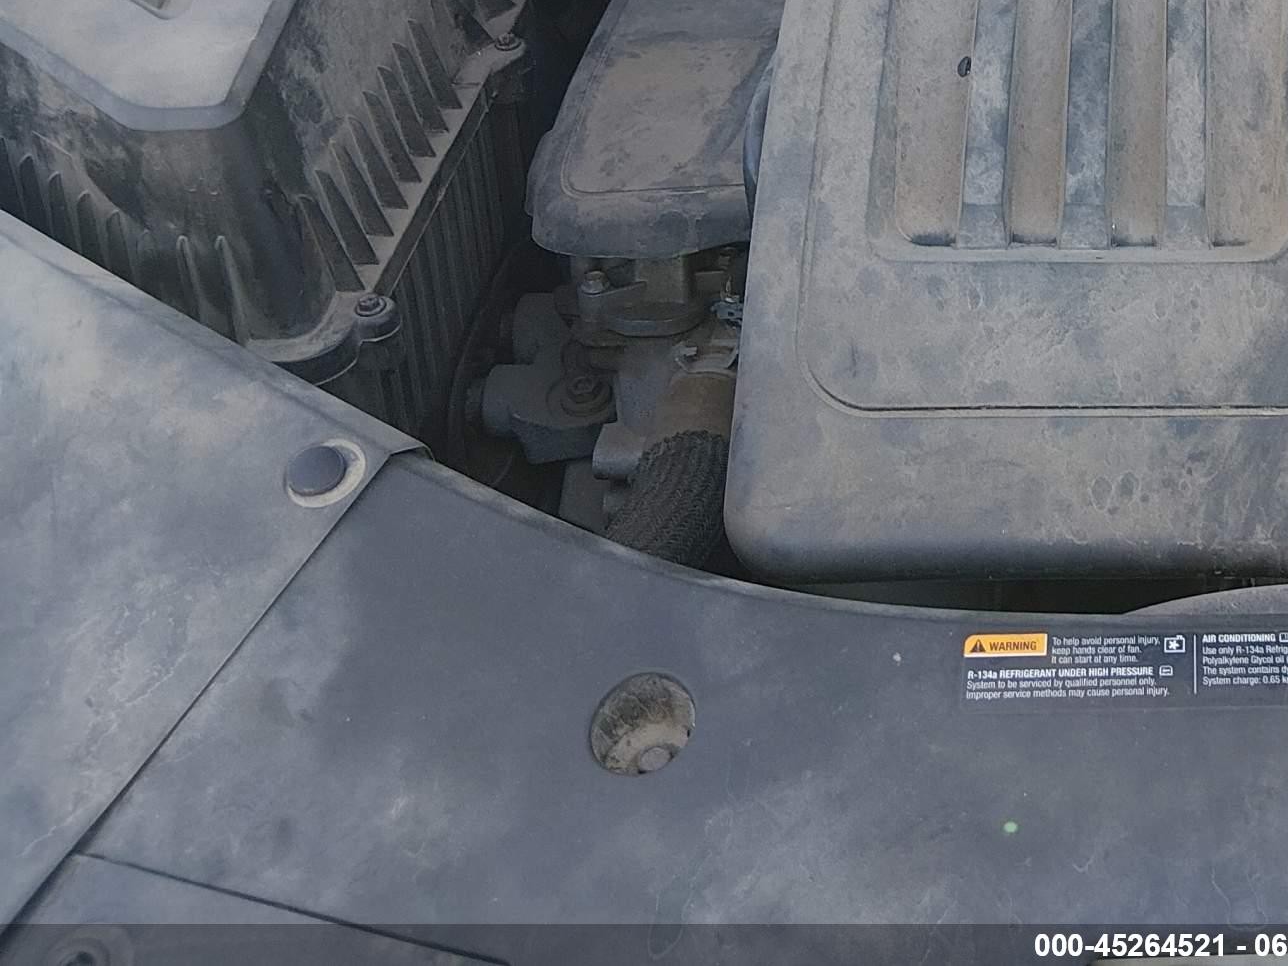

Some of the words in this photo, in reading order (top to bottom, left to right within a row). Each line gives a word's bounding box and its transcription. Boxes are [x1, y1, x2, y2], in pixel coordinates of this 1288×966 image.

[1052, 637, 1062, 646] To
[1063, 637, 1079, 647] help
[1081, 636, 1101, 645] avoid
[1104, 636, 1136, 646] personal
[1202, 634, 1216, 643] AIR
[1218, 634, 1276, 642] CONDITIONING
[989, 641, 1037, 652] WARNING
[1051, 646, 1071, 656] keep
[1072, 646, 1095, 654] hands
[1097, 645, 1116, 654] clear
[1118, 645, 1126, 653] of
[1127, 645, 1142, 653] fan.
[1202, 646, 1217, 655] Use
[1218, 646, 1234, 656] only
[1235, 645, 1264, 654] R-134a
[1051, 656, 1057, 664] It
[1058, 656, 1073, 664] can
[1074, 655, 1092, 664] start
[1093, 655, 1102, 663] at
[1104, 655, 1117, 664] any
[1119, 654, 1139, 663] time.
[1202, 656, 1249, 666] Polyalkylene
[1250, 655, 1274, 665] Glycol
[1275, 655, 1285, 664] oil
[967, 670, 998, 680] R-134a
[999, 668, 1056, 679] REFRIGERANT
[1058, 667, 1087, 678] UNDER
[1088, 667, 1109, 677] HIGH
[1110, 666, 1154, 676] PRESSURE
[1203, 666, 1217, 675] The
[1218, 666, 1246, 676] system
[1248, 665, 1280, 674] contains
[966, 680, 995, 690] System
[998, 680, 1005, 689] to
[1007, 679, 1017, 688] be
[1019, 679, 1051, 688] serviced
[1053, 678, 1063, 689] by
[1065, 677, 1098, 688] qualified
[1099, 677, 1137, 687] personnel
[1138, 676, 1157, 686] only.
[1202, 676, 1231, 687] System
[1232, 675, 1261, 686] charge:
[1262, 675, 1280, 684] 0.65
[966, 690, 1001, 701] Improper
[1002, 690, 1031, 699] service
[1033, 689, 1066, 698] methods
[1068, 689, 1085, 699] may
[1087, 688, 1110, 697] cause
[1111, 687, 1145, 697] personal
[1146, 686, 1170, 697] injury.
